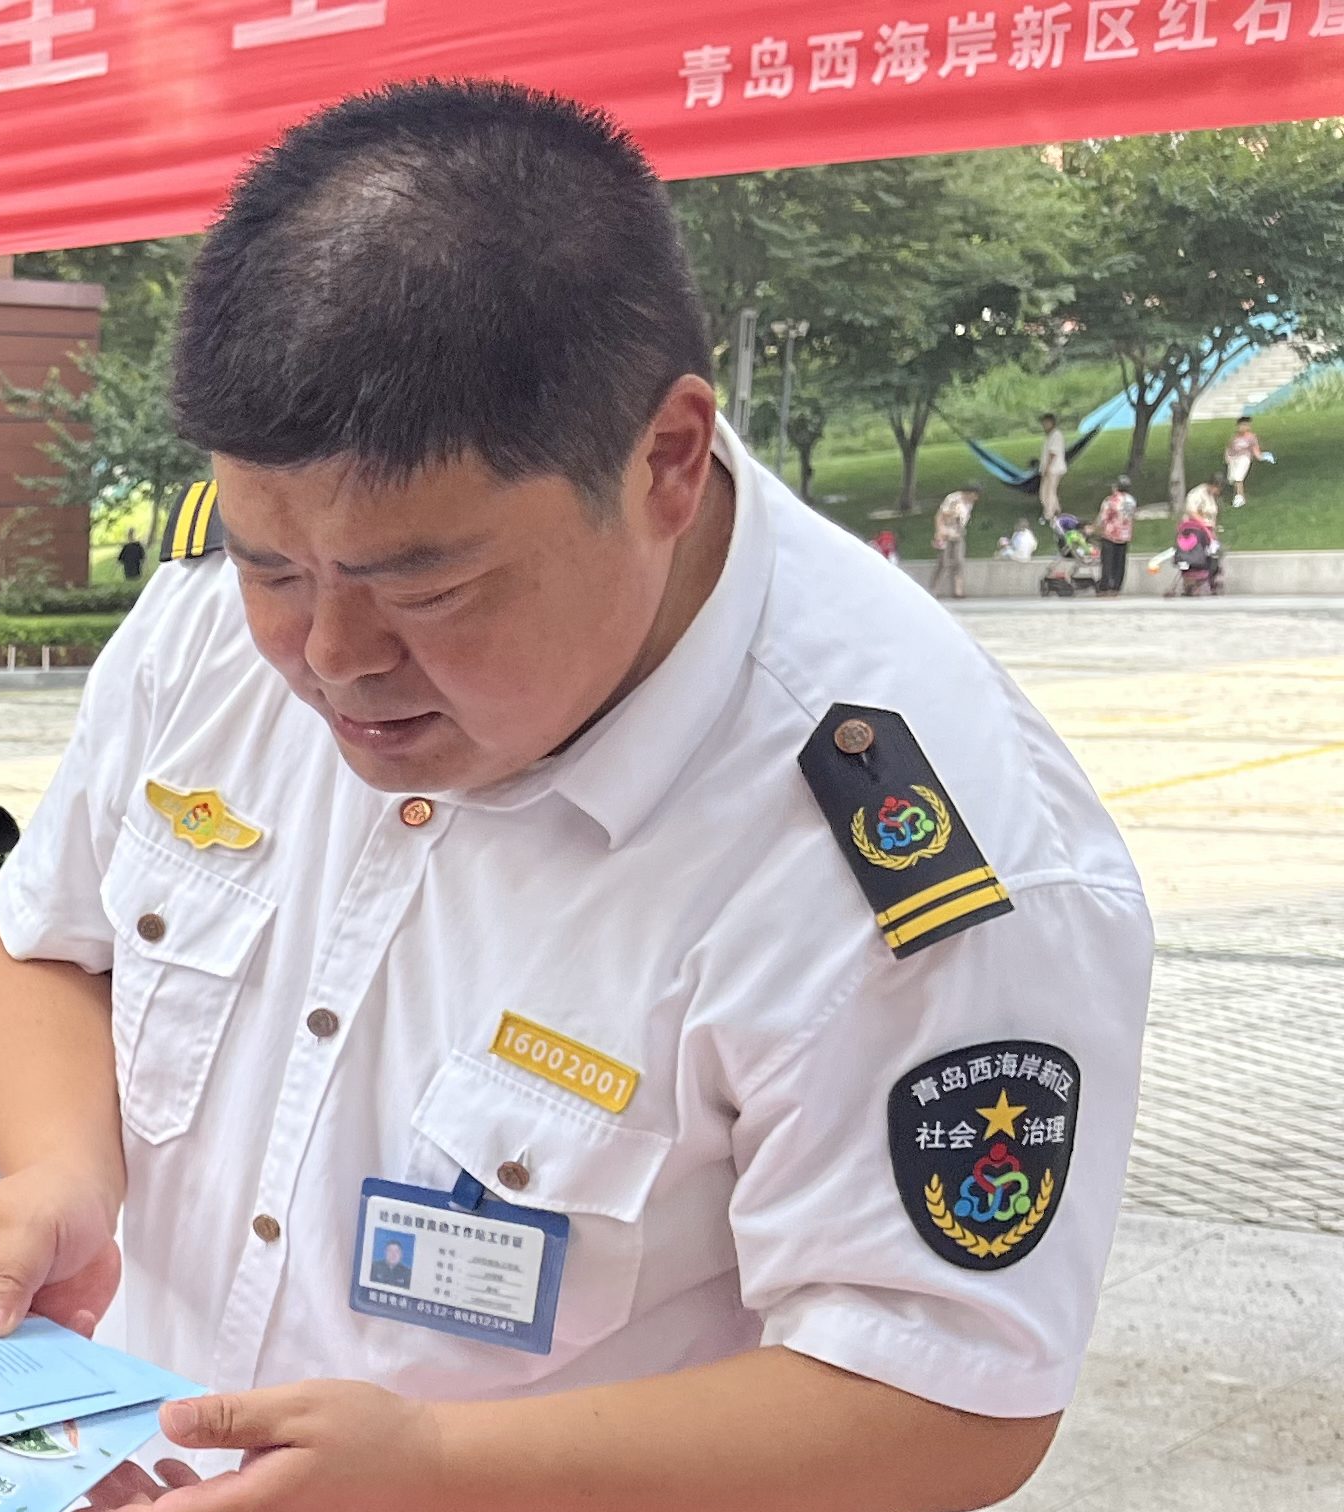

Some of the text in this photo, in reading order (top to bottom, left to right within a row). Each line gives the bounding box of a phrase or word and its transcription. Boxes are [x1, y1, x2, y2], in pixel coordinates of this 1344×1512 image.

[503, 1026, 628, 1102] 16002001
[911, 1051, 1074, 1106] 青岛西海岸新区
[915, 1115, 1065, 1150] 社会 治理
